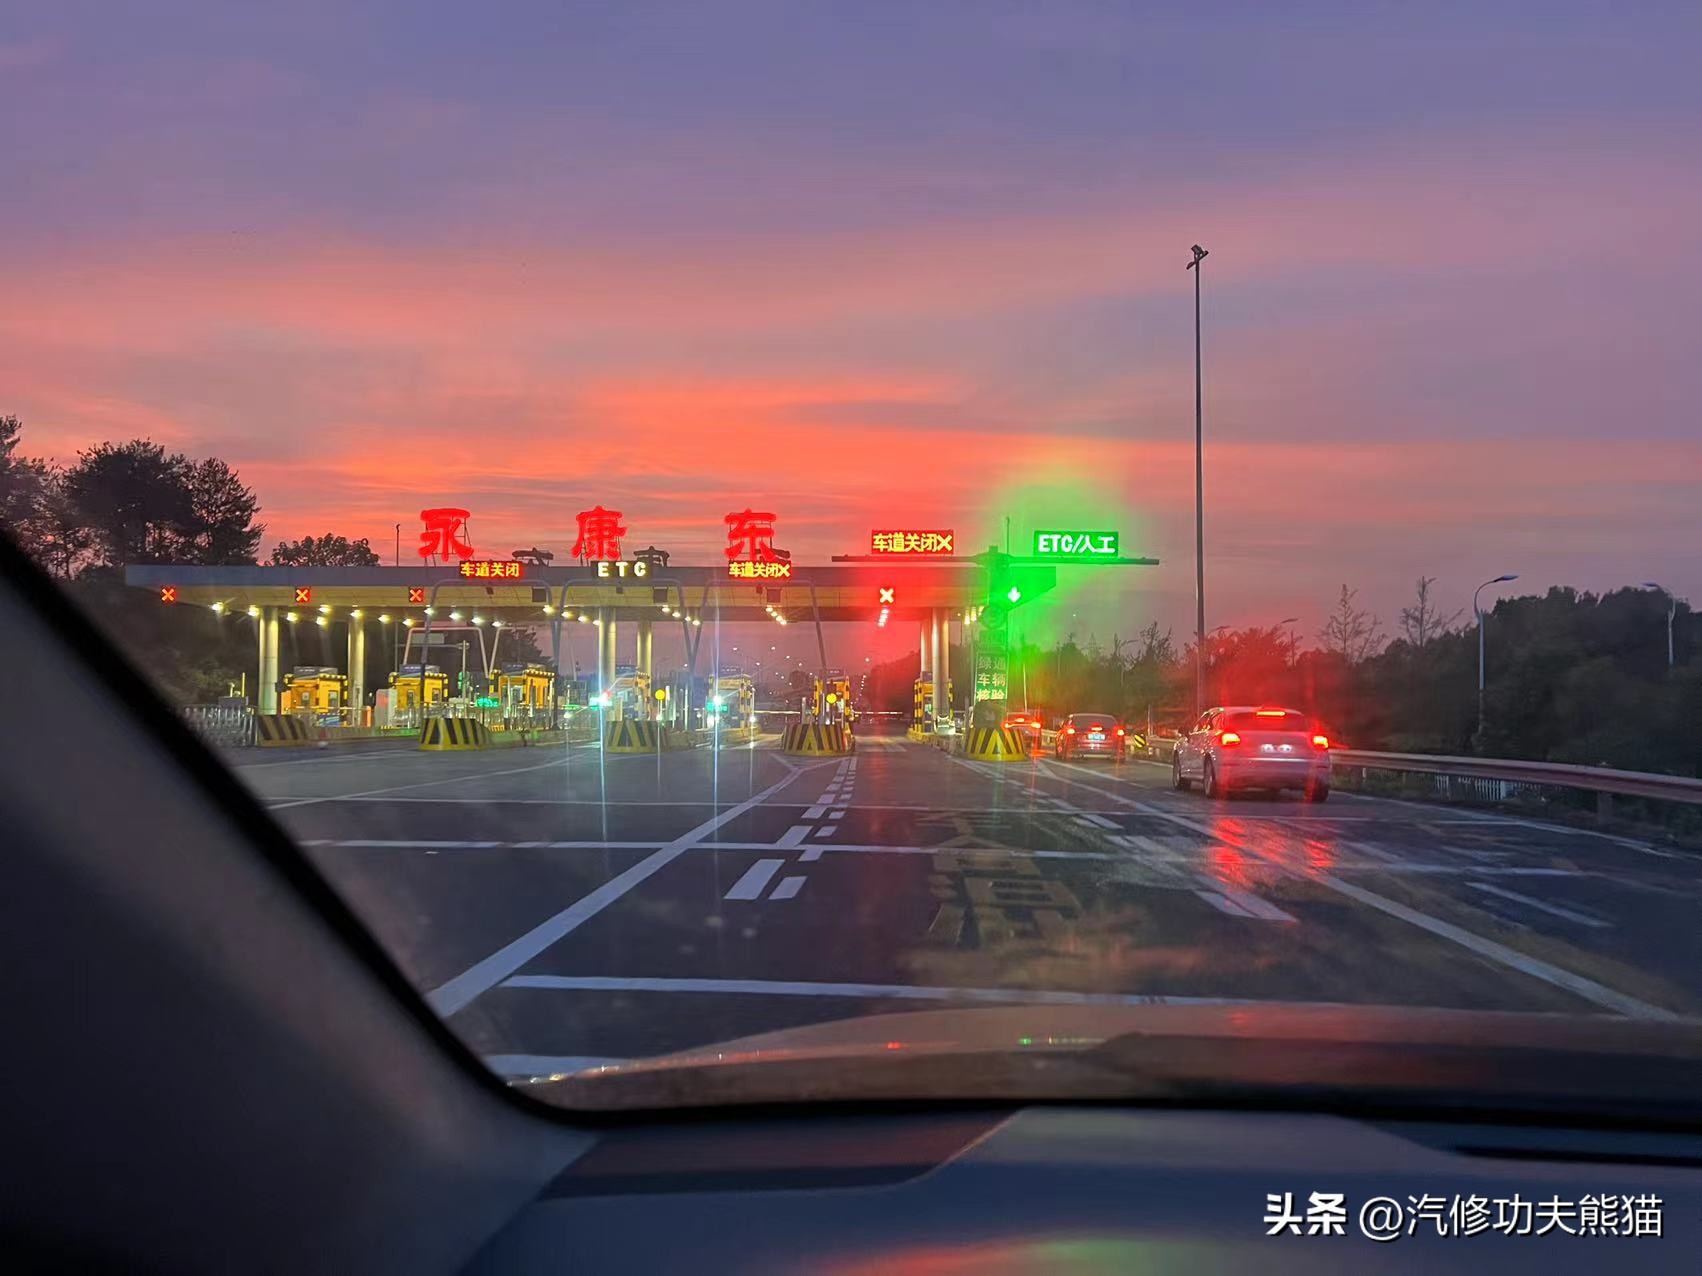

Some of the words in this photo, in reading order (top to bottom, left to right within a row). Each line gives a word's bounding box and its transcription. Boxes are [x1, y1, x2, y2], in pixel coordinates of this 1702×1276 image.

[1037, 534, 1116, 554] ETC/人工
[460, 561, 520, 577] 车道关闭
[597, 561, 648, 577] ETC
[977, 673, 1006, 687] 车辆
